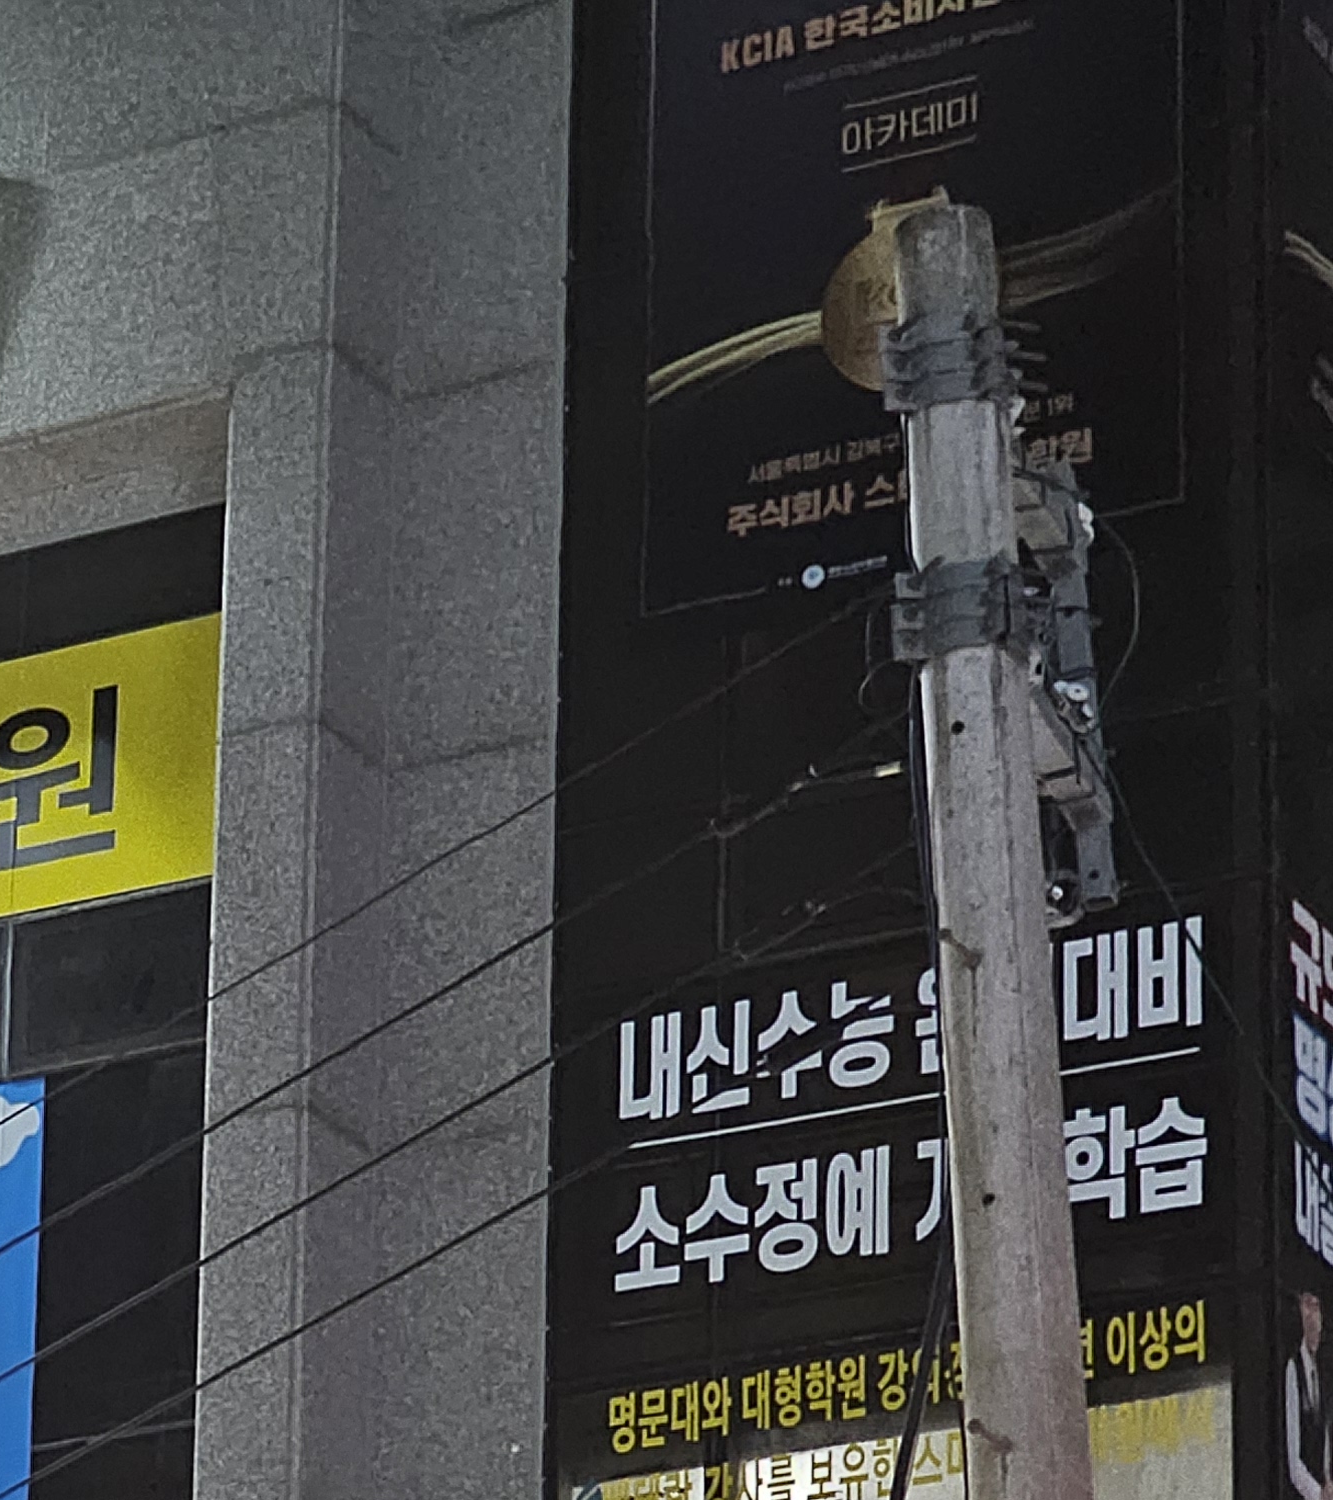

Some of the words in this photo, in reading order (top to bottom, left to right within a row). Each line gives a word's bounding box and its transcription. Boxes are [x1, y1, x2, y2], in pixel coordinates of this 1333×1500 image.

[720, 26, 796, 74] KCIA
[803, 0, 1001, 51] 한국소비
[841, 91, 979, 156] 아카데미
[728, 480, 855, 538] 주식회사
[618, 980, 896, 1121] 내신수능
[613, 1143, 892, 1292] 소수정예
[607, 1375, 733, 1454] 명문대와
[740, 1353, 868, 1429] 대형학원
[1105, 1300, 1207, 1375] 이상의
